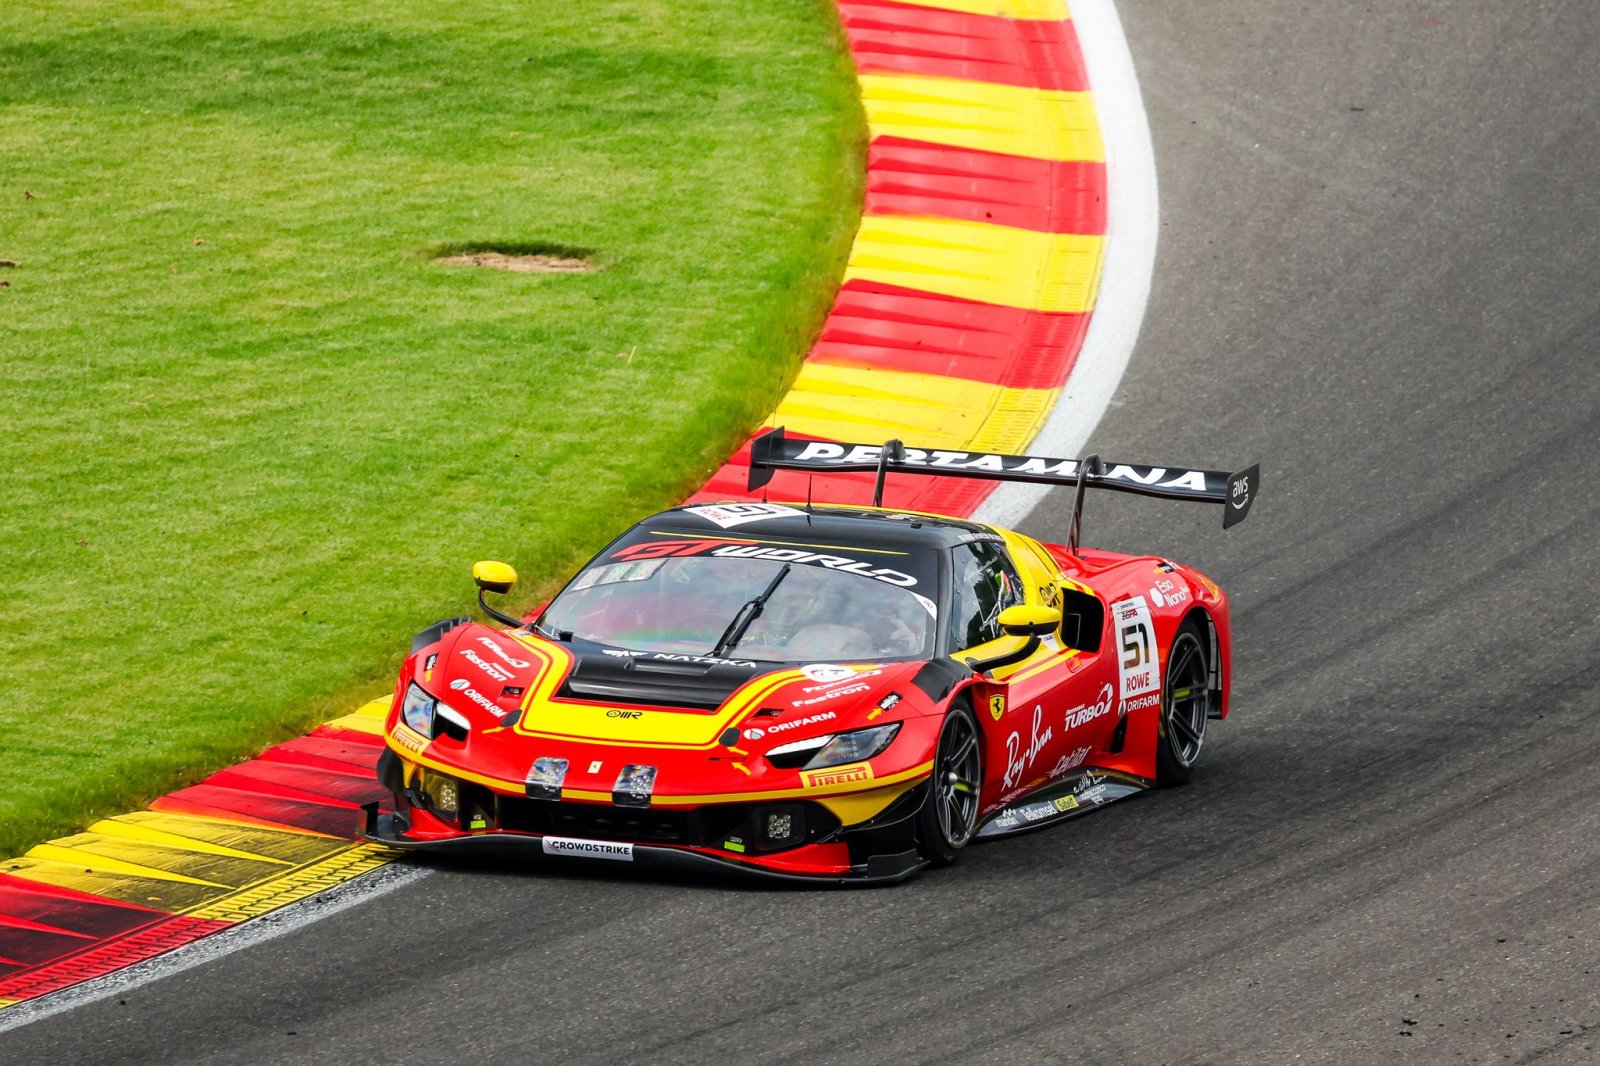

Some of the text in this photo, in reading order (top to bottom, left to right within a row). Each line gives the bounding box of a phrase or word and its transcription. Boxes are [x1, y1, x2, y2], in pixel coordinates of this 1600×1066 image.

[795, 442, 1206, 491] PERTAMNA
[1233, 476, 1248, 498] aws
[610, 540, 918, 587] GT WORLD
[1122, 623, 1150, 670] 51
[459, 649, 508, 681] Fastron
[653, 653, 757, 668] NATZKA
[1126, 672, 1150, 692] ROWE
[463, 688, 508, 718] ORIFARM
[1127, 694, 1160, 712] ORIFARM
[767, 712, 837, 733] ORIFARM
[1065, 701, 1105, 732] TURBO
[391, 727, 425, 754] PIRELLI
[808, 767, 868, 788] PIRELLI
[552, 841, 630, 855] CROWDSTRIKE
